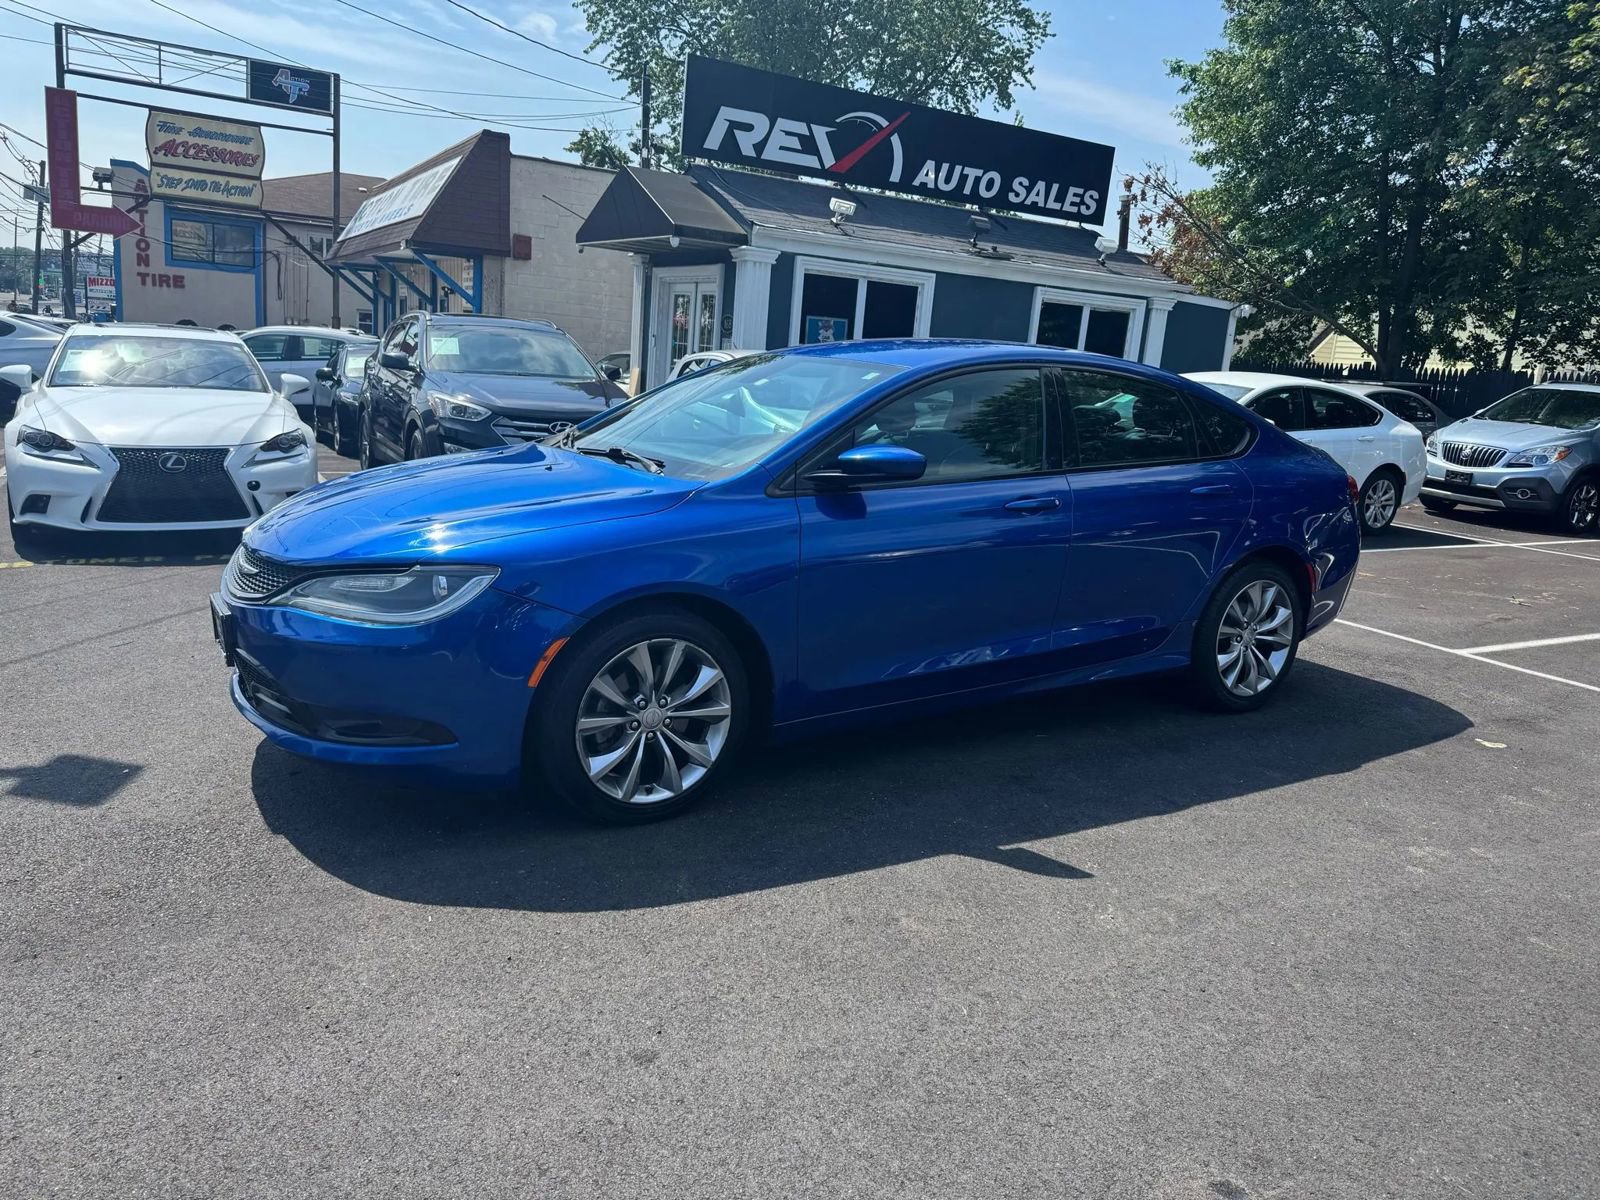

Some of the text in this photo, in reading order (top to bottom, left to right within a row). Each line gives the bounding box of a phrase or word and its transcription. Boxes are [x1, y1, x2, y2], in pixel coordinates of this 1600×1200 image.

[153, 138, 260, 168] ACCESSORIES
[912, 159, 1099, 217] AUTO SALES
[136, 272, 185, 289] TIRE
